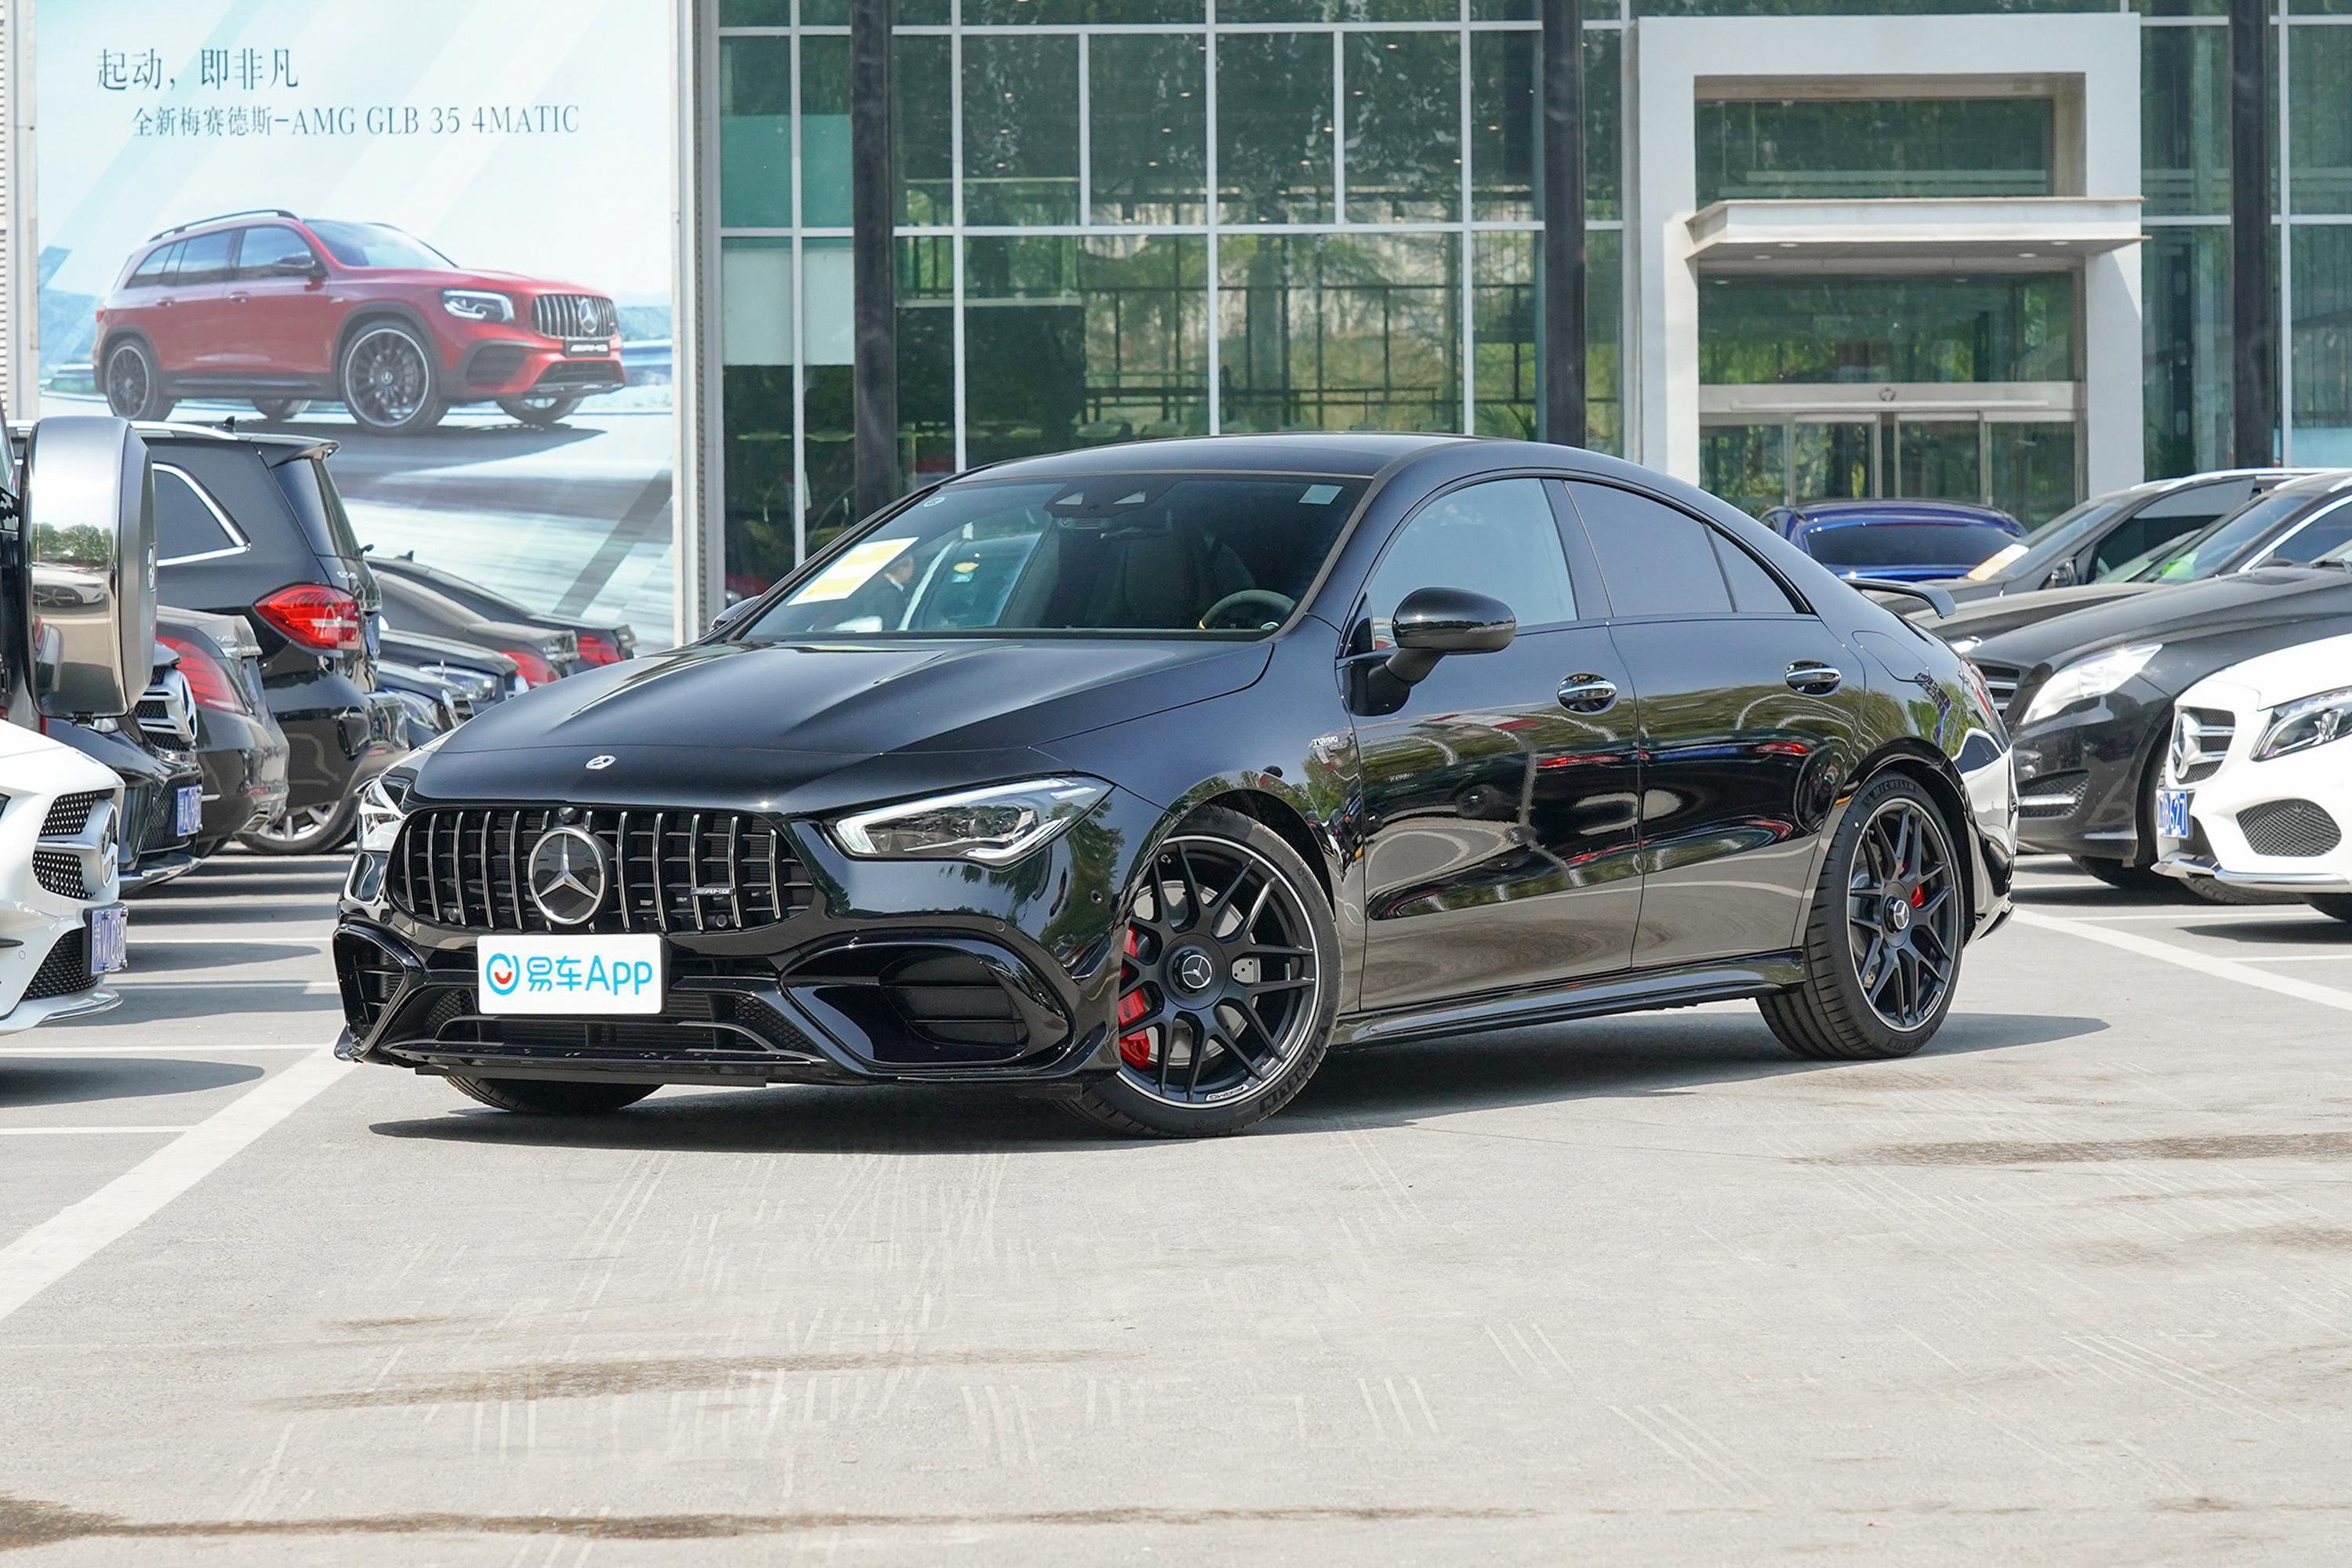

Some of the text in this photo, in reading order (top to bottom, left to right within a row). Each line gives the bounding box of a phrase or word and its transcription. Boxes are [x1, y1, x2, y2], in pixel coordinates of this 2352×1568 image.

[96, 48, 299, 91] 起动，即非凡
[366, 106, 419, 134] GLB
[430, 107, 461, 134] 35
[471, 105, 579, 133] 4MATIC
[527, 955, 652, 996] 易车App
